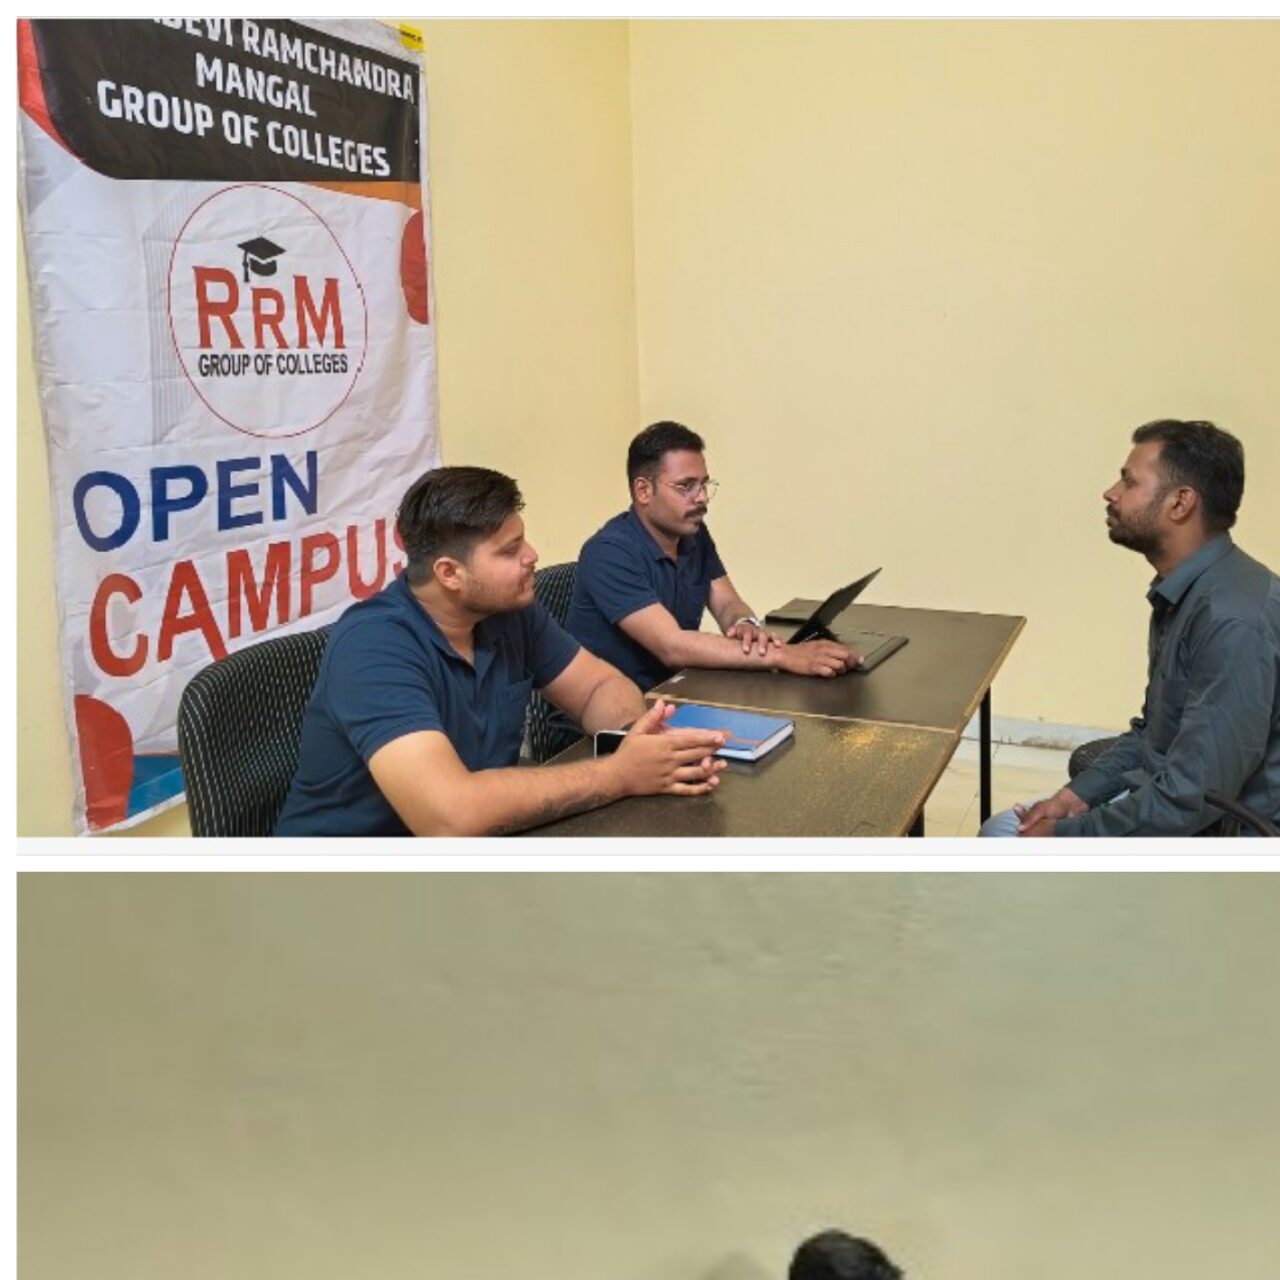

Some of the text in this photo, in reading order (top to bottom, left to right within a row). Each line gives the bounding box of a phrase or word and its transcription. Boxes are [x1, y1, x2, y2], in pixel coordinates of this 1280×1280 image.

[195, 52, 317, 118] MANGAL
[242, 19, 415, 104] RAMCHANDRA
[97, 79, 391, 176] GROUP OF COLLEGES
[192, 265, 345, 349] RRM
[198, 353, 349, 378] GROUP OF COLLEGES
[73, 450, 318, 552] OPEN
